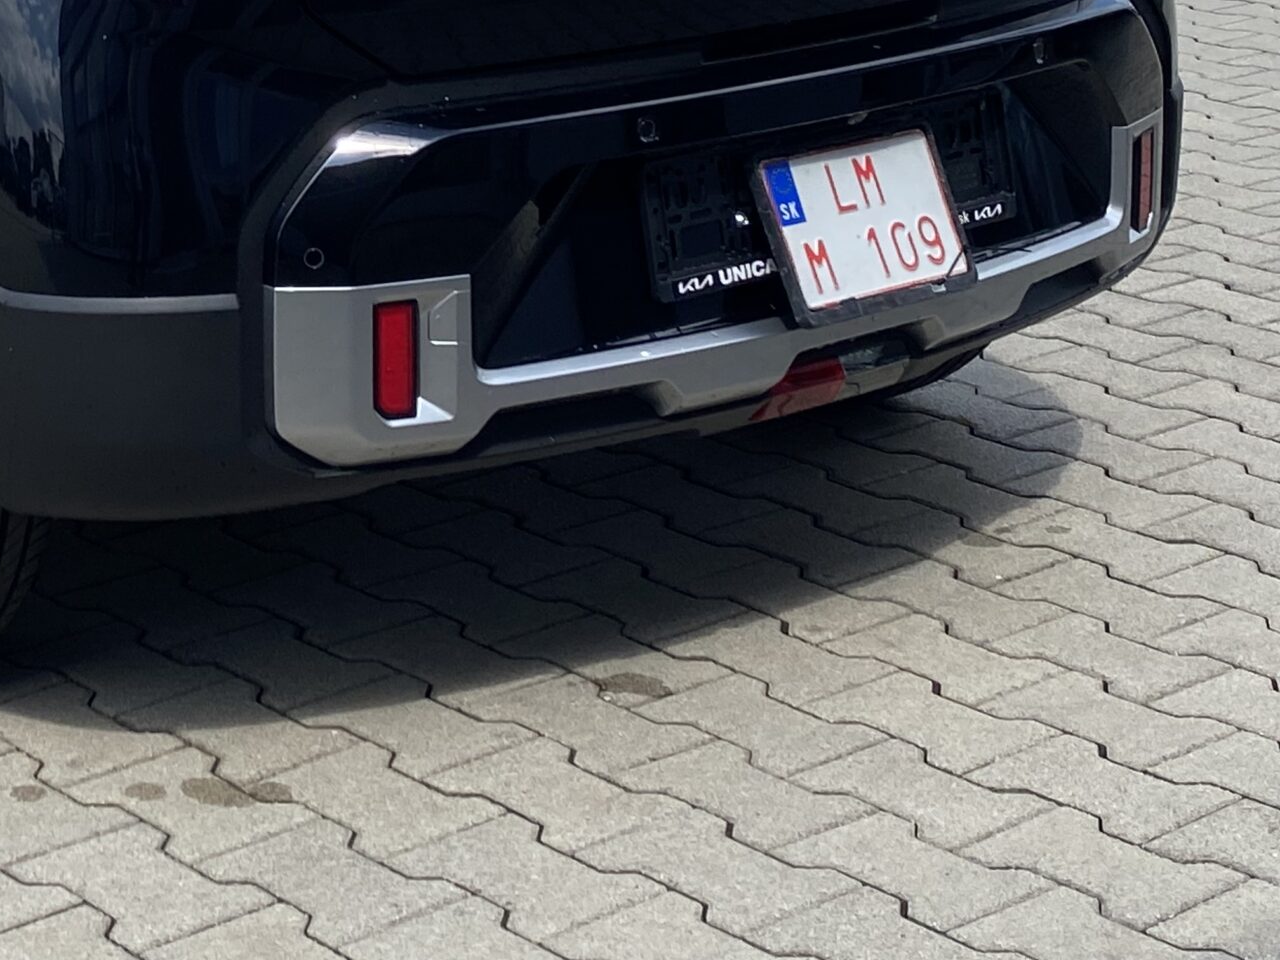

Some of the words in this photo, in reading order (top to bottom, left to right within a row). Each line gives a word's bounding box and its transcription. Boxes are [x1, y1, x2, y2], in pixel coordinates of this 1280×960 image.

[824, 154, 886, 215] LM
[780, 203, 801, 221] SK
[804, 239, 839, 295] M
[865, 215, 945, 278] 109
[678, 274, 714, 294] KIA
